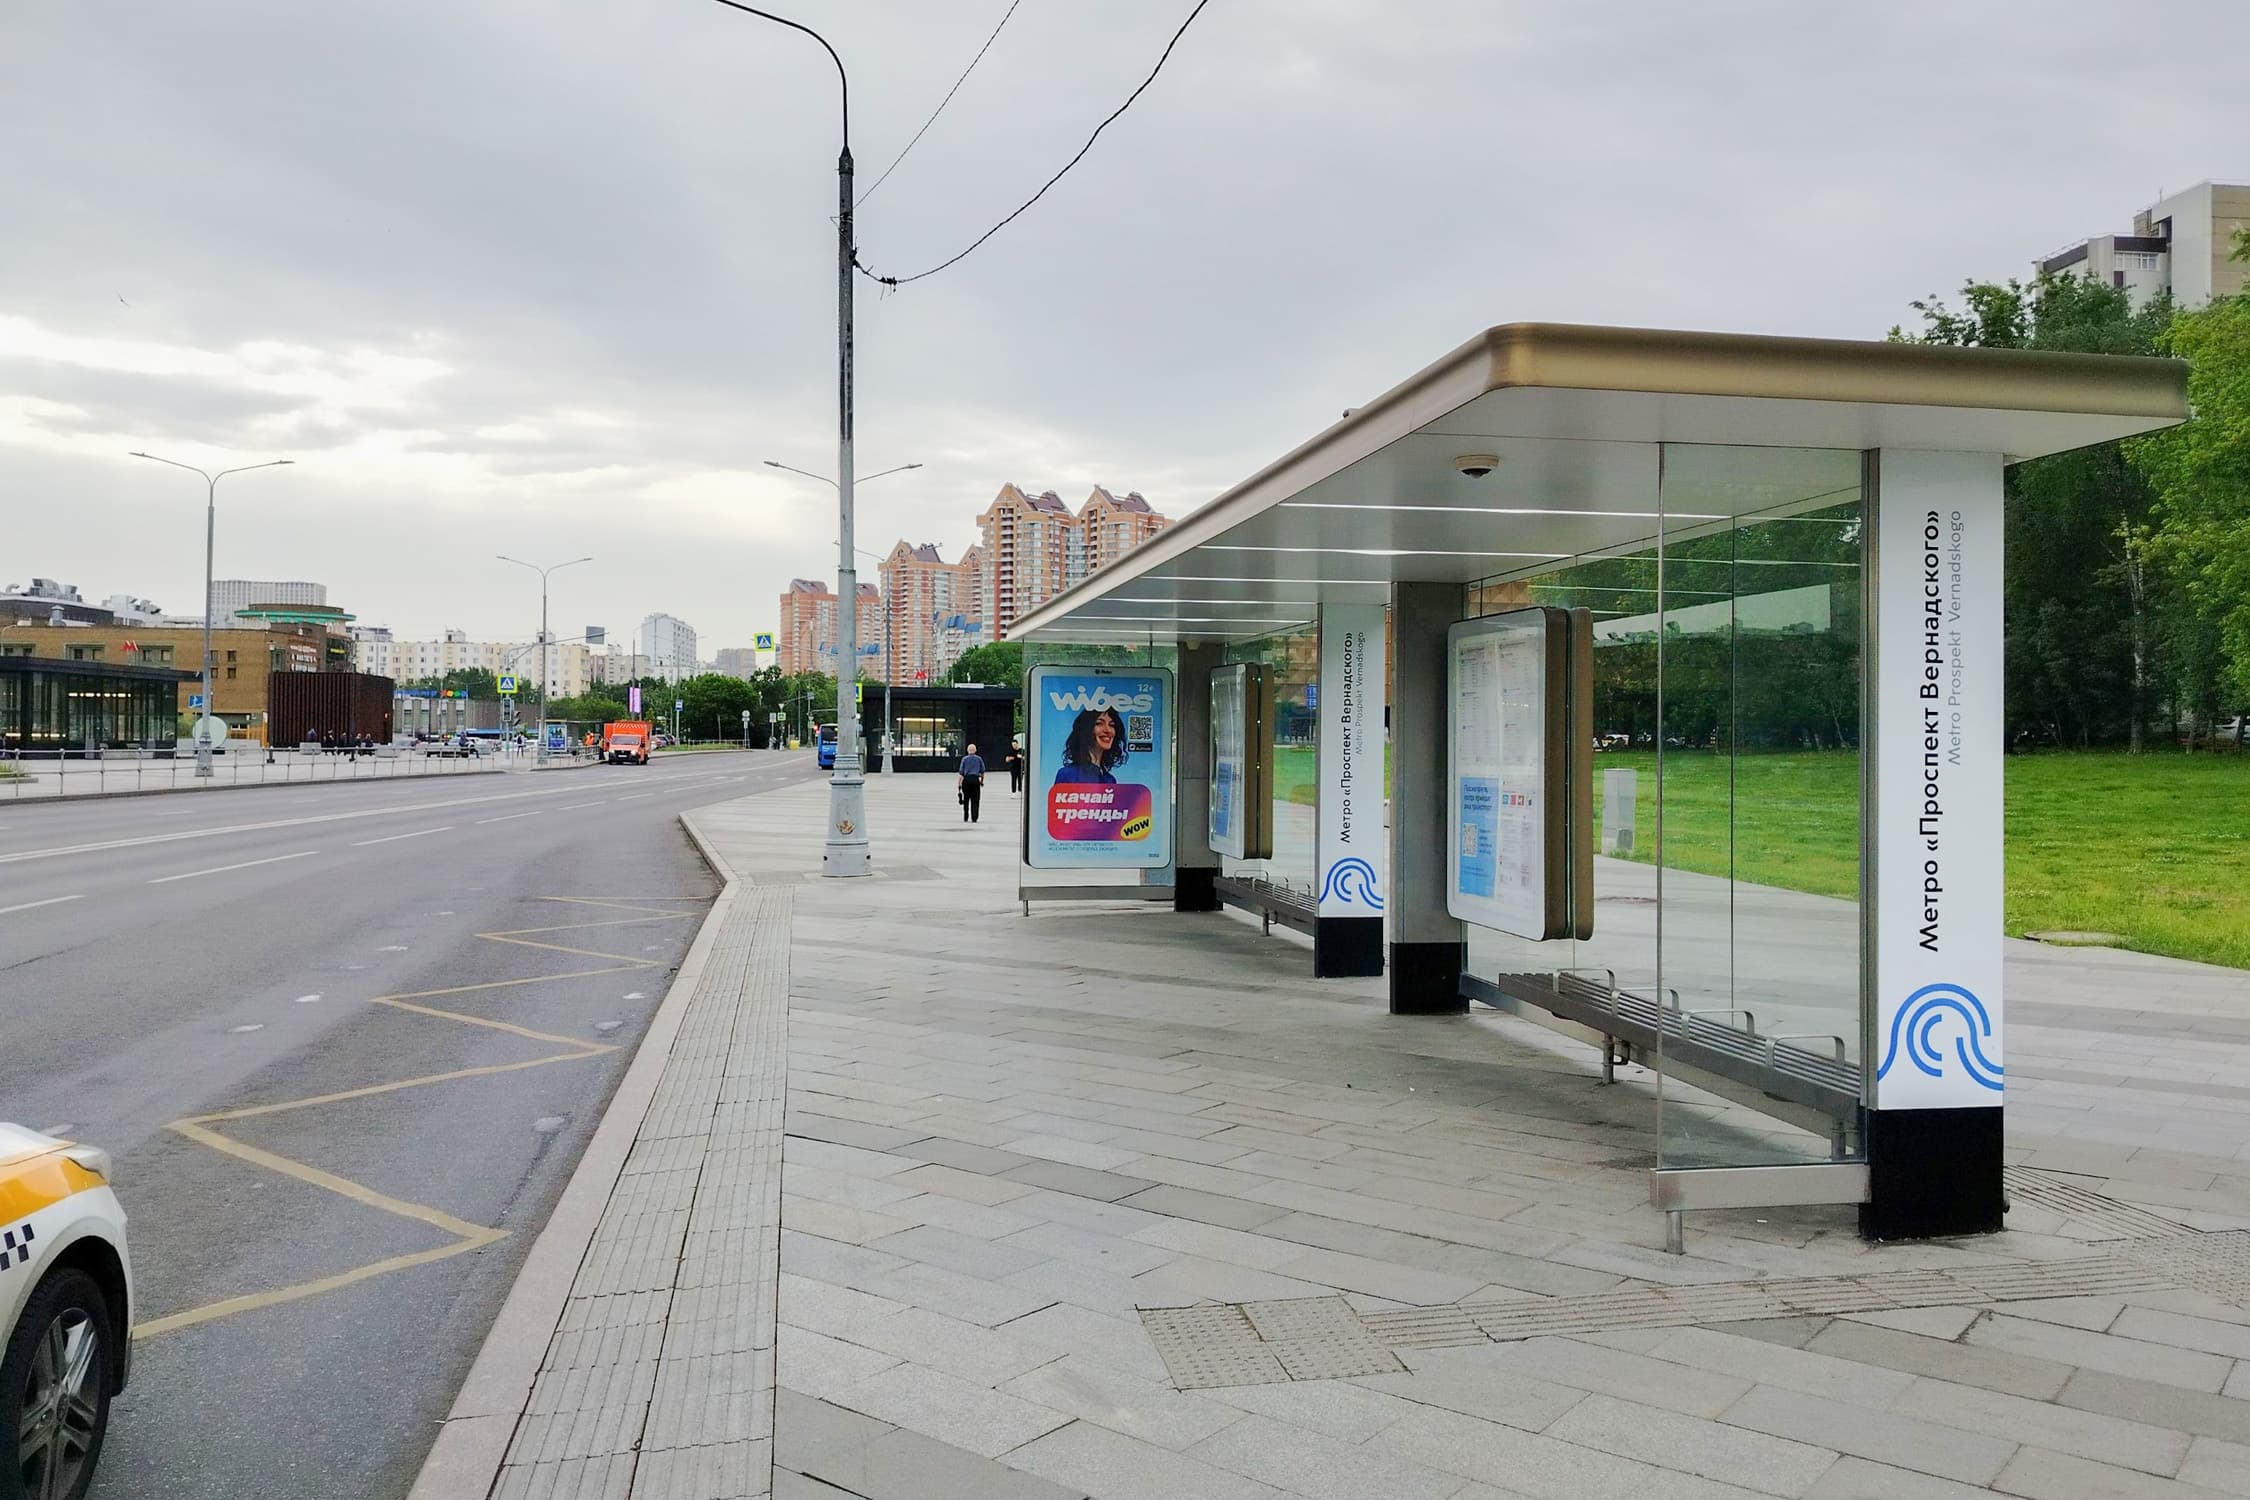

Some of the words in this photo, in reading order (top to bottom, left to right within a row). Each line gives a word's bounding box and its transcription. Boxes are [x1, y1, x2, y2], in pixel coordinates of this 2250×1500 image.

[1947, 510, 1965, 623] Vernadskogo
[1919, 510, 1943, 699] Вернадского»
[1340, 632, 1353, 724] Вернадского»
[1355, 632, 1365, 687] Vernadskogo
[1947, 631, 1965, 706] Prospekt
[1050, 685, 1153, 712] wibes
[1355, 690, 1365, 727] Prospekt
[1340, 726, 1353, 796] «Проспект
[1355, 729, 1363, 755] Metro
[1947, 711, 1961, 766] Metro
[1055, 788, 1114, 803] качай
[1919, 707, 1943, 851] «Проспект
[1055, 808, 1128, 823] тренды
[1340, 799, 1352, 844] Метро
[1919, 860, 1943, 953] Метро
